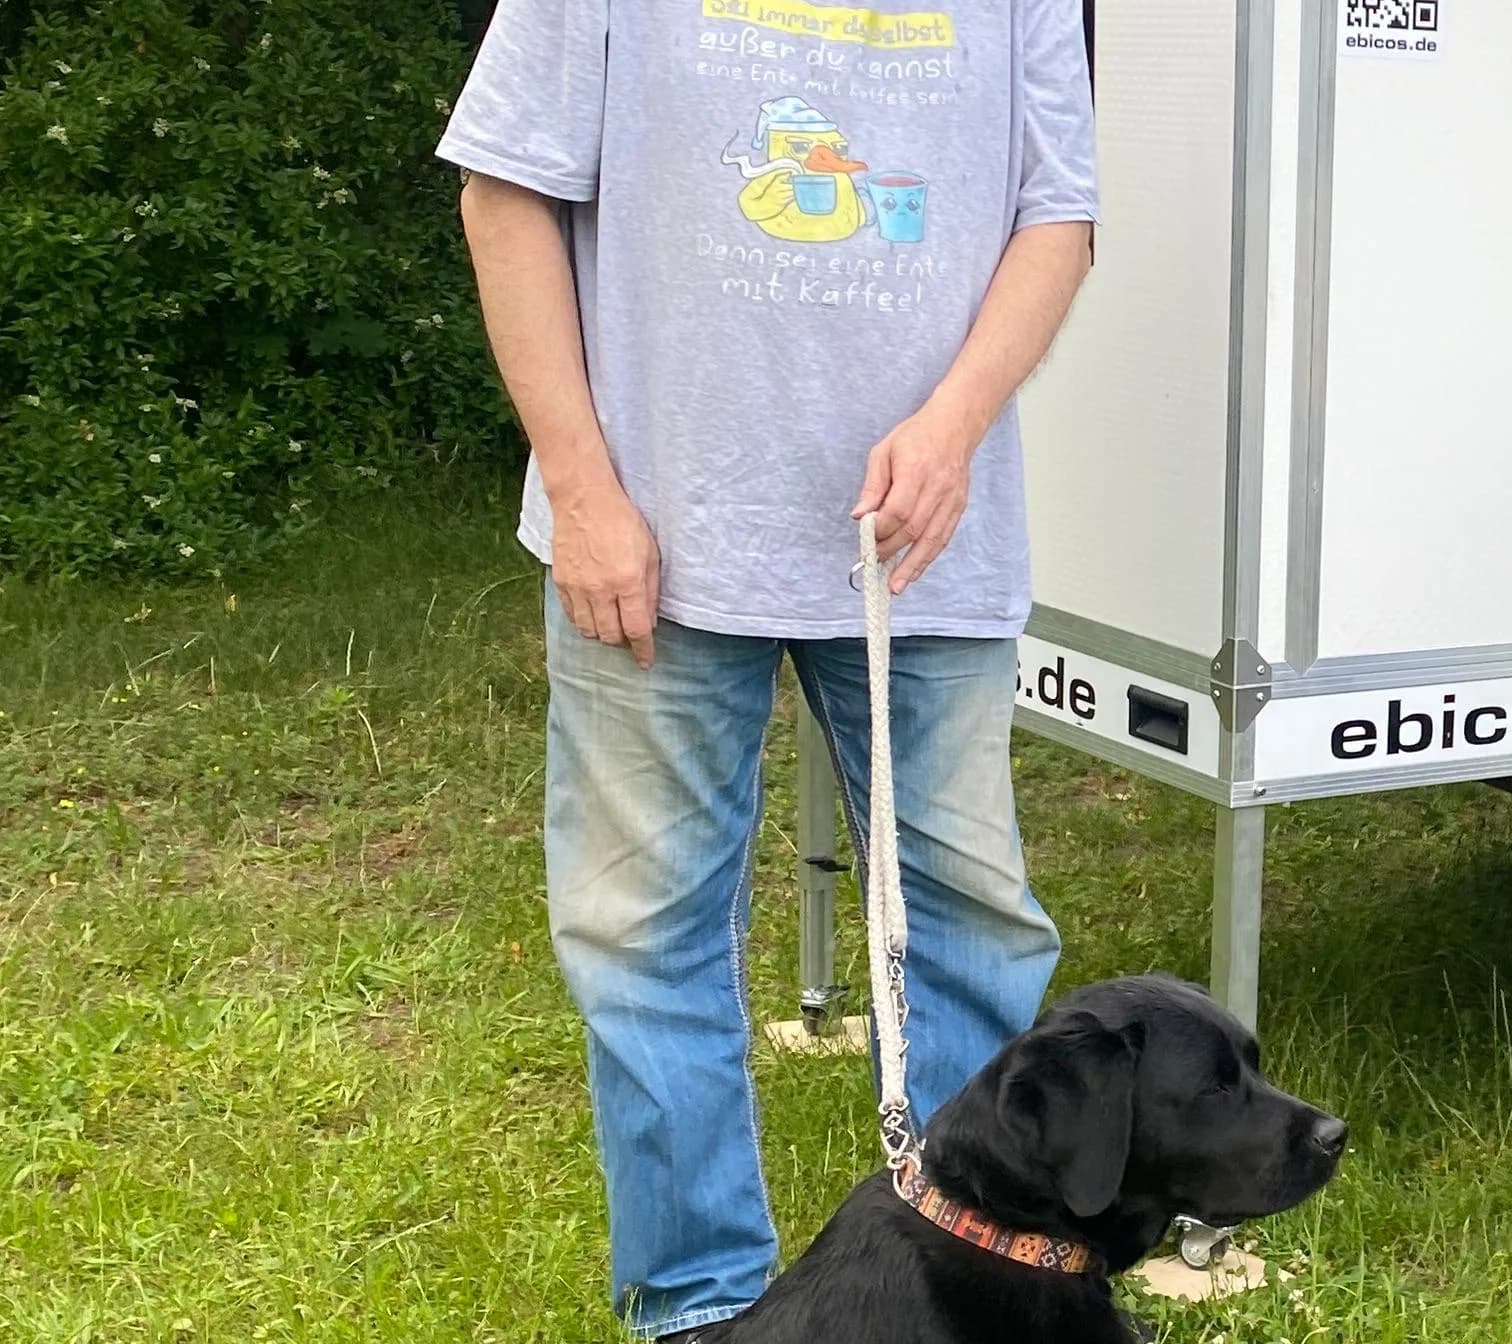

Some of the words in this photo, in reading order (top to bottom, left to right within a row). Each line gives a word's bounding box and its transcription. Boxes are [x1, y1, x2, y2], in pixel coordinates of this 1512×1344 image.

[757, 5, 833, 34] immer
[698, 26, 797, 59] außer
[805, 41, 846, 72] du
[1345, 33, 1438, 52] ebicos.de
[695, 61, 743, 81] eine
[695, 233, 765, 266] Dann
[776, 251, 817, 272] sei
[827, 257, 886, 276] eine
[896, 254, 949, 278] Ente
[721, 271, 785, 303] mit
